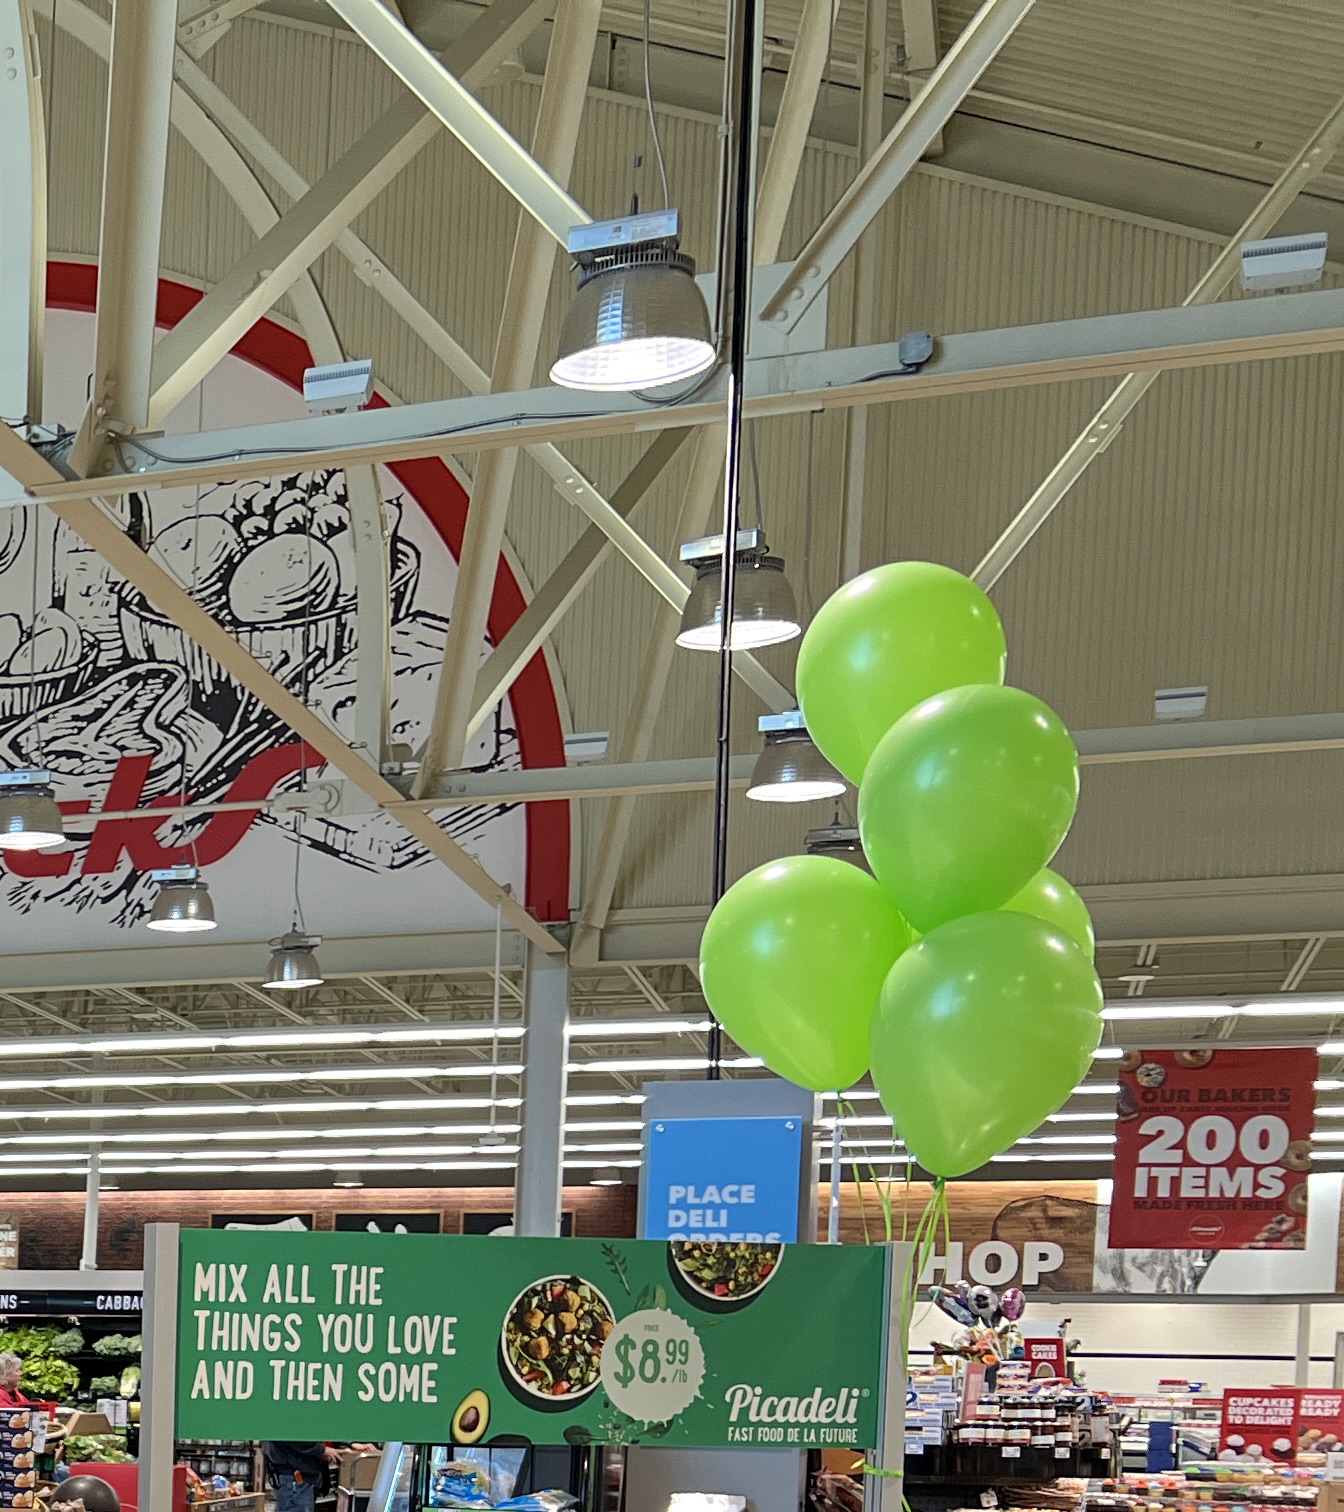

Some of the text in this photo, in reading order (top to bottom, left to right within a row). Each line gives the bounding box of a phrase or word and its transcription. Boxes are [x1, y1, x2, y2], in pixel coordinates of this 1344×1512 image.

[1141, 1087, 1292, 1104] OUR BAKERS
[1138, 1114, 1290, 1165] 200
[1133, 1166, 1287, 1199] ITEMS
[668, 1184, 756, 1205] PLACE
[1242, 1200, 1284, 1211] HERE
[667, 1209, 728, 1229] DELI
[193, 1262, 384, 1306] MIX ALL THE
[193, 1309, 458, 1356] THINGS YOU LOVE
[643, 1324, 660, 1332] PRICE
[613, 1333, 690, 1389] $8.99
[190, 1359, 439, 1403] AND THEN SOME
[1228, 1396, 1295, 1407] CUPCAKES
[1228, 1406, 1294, 1416] DECORATED
[1228, 1415, 1243, 1425] TO
[727, 1426, 859, 1443] FAST FOOD DE LA FUTURE
